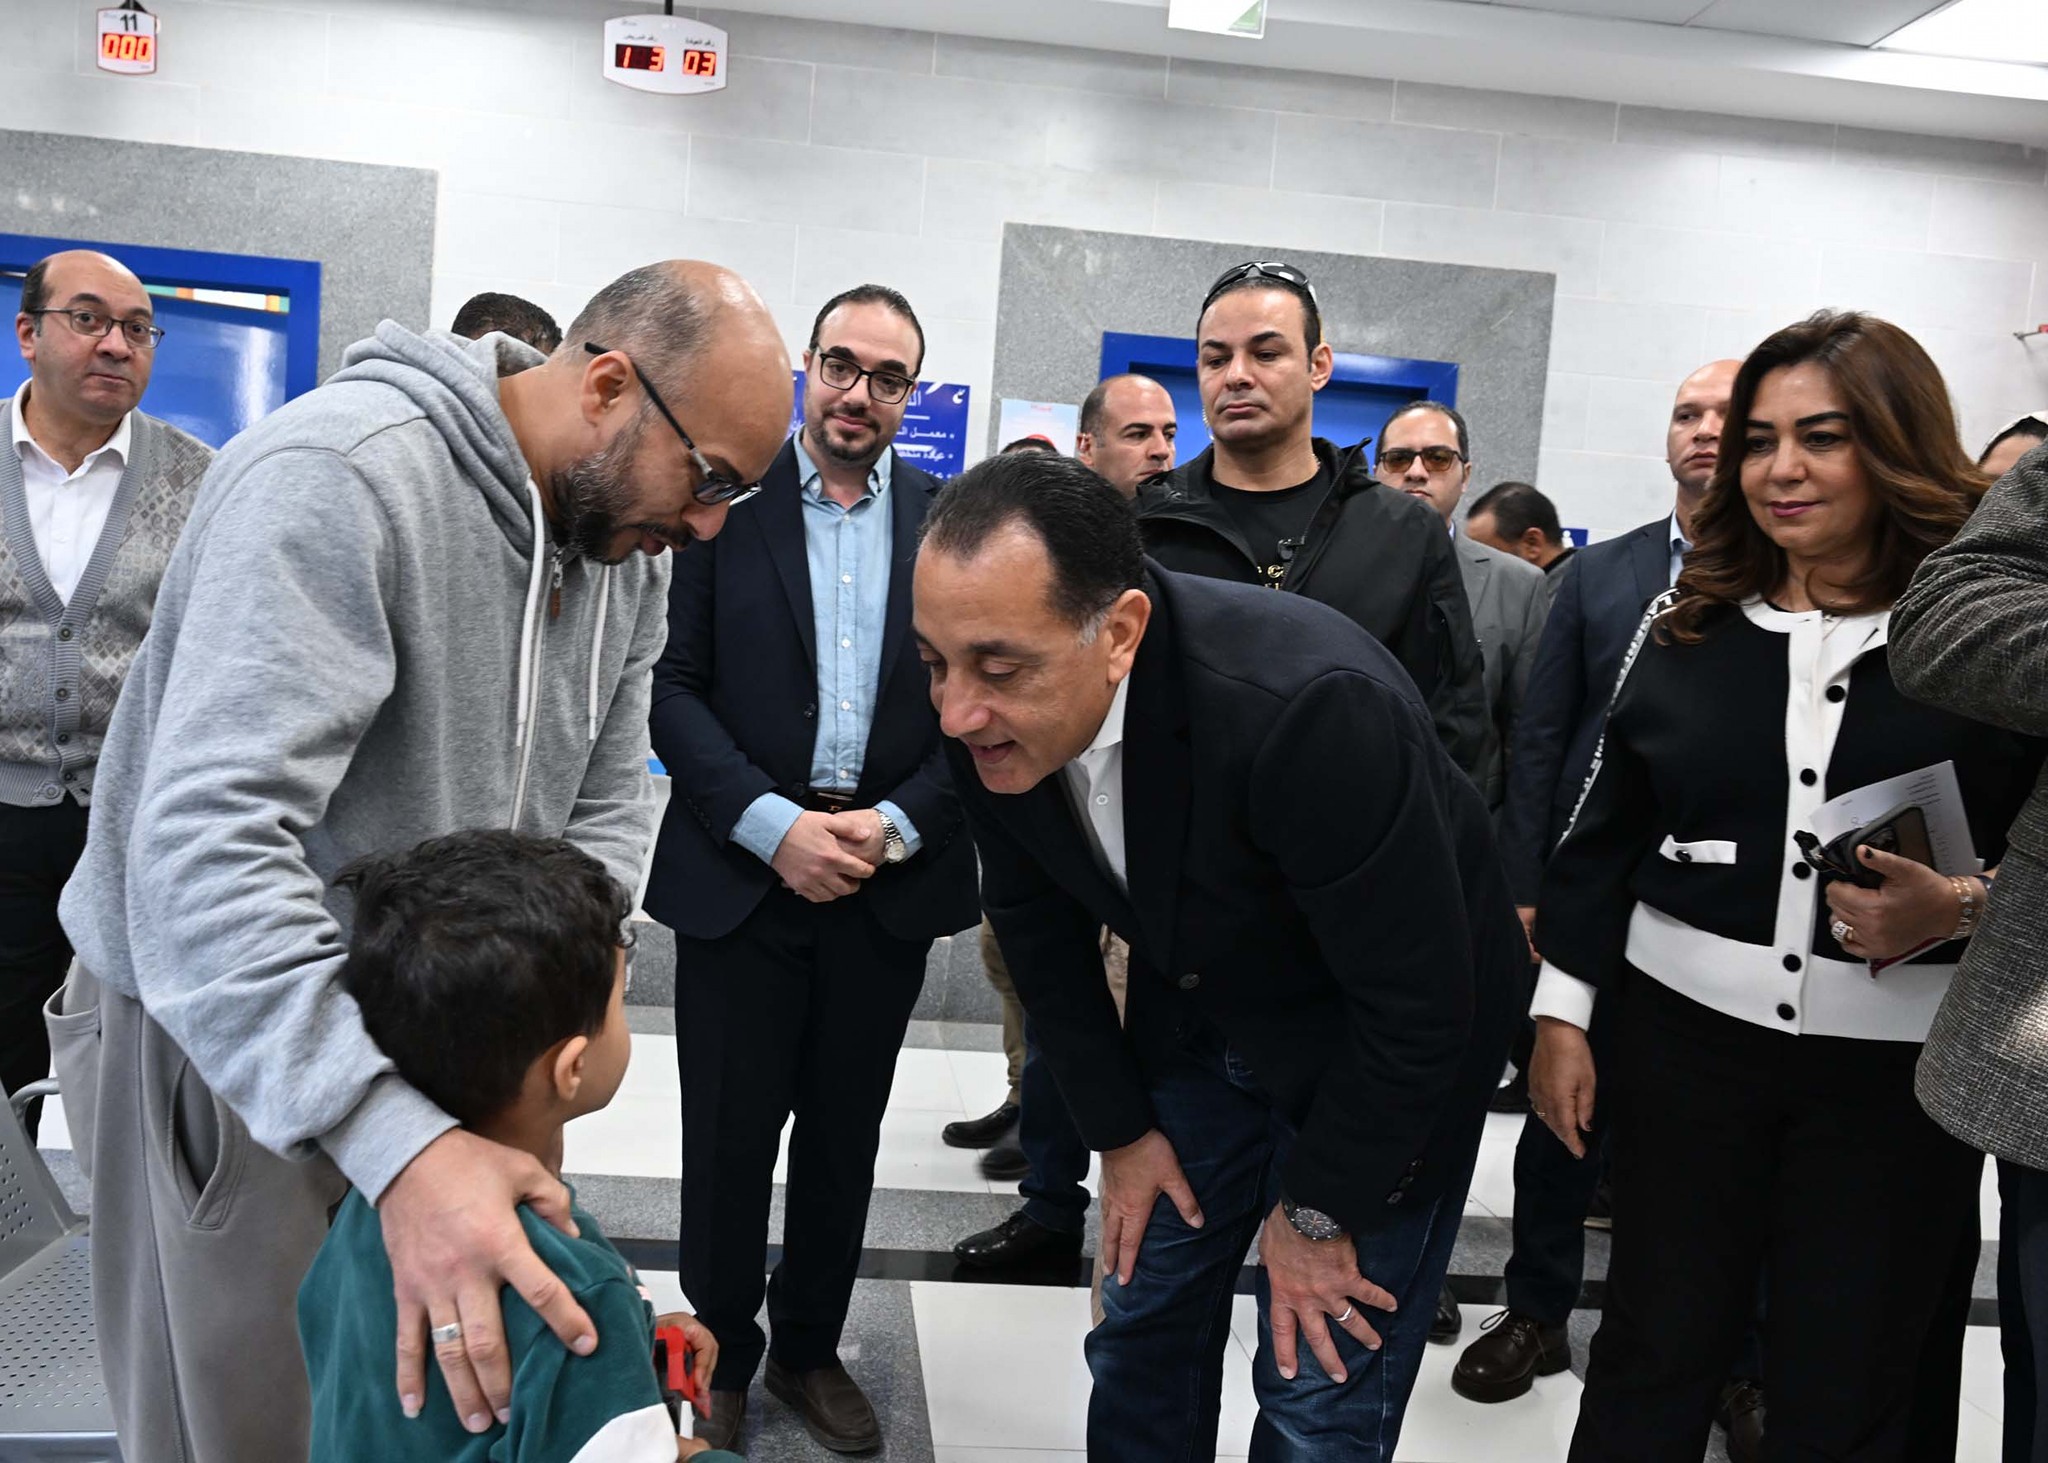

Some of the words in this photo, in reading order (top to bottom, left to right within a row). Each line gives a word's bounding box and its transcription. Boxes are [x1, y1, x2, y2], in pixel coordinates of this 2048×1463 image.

[120, 13, 138, 32] 11
[103, 34, 153, 62] 000
[683, 51, 716, 77] 03
